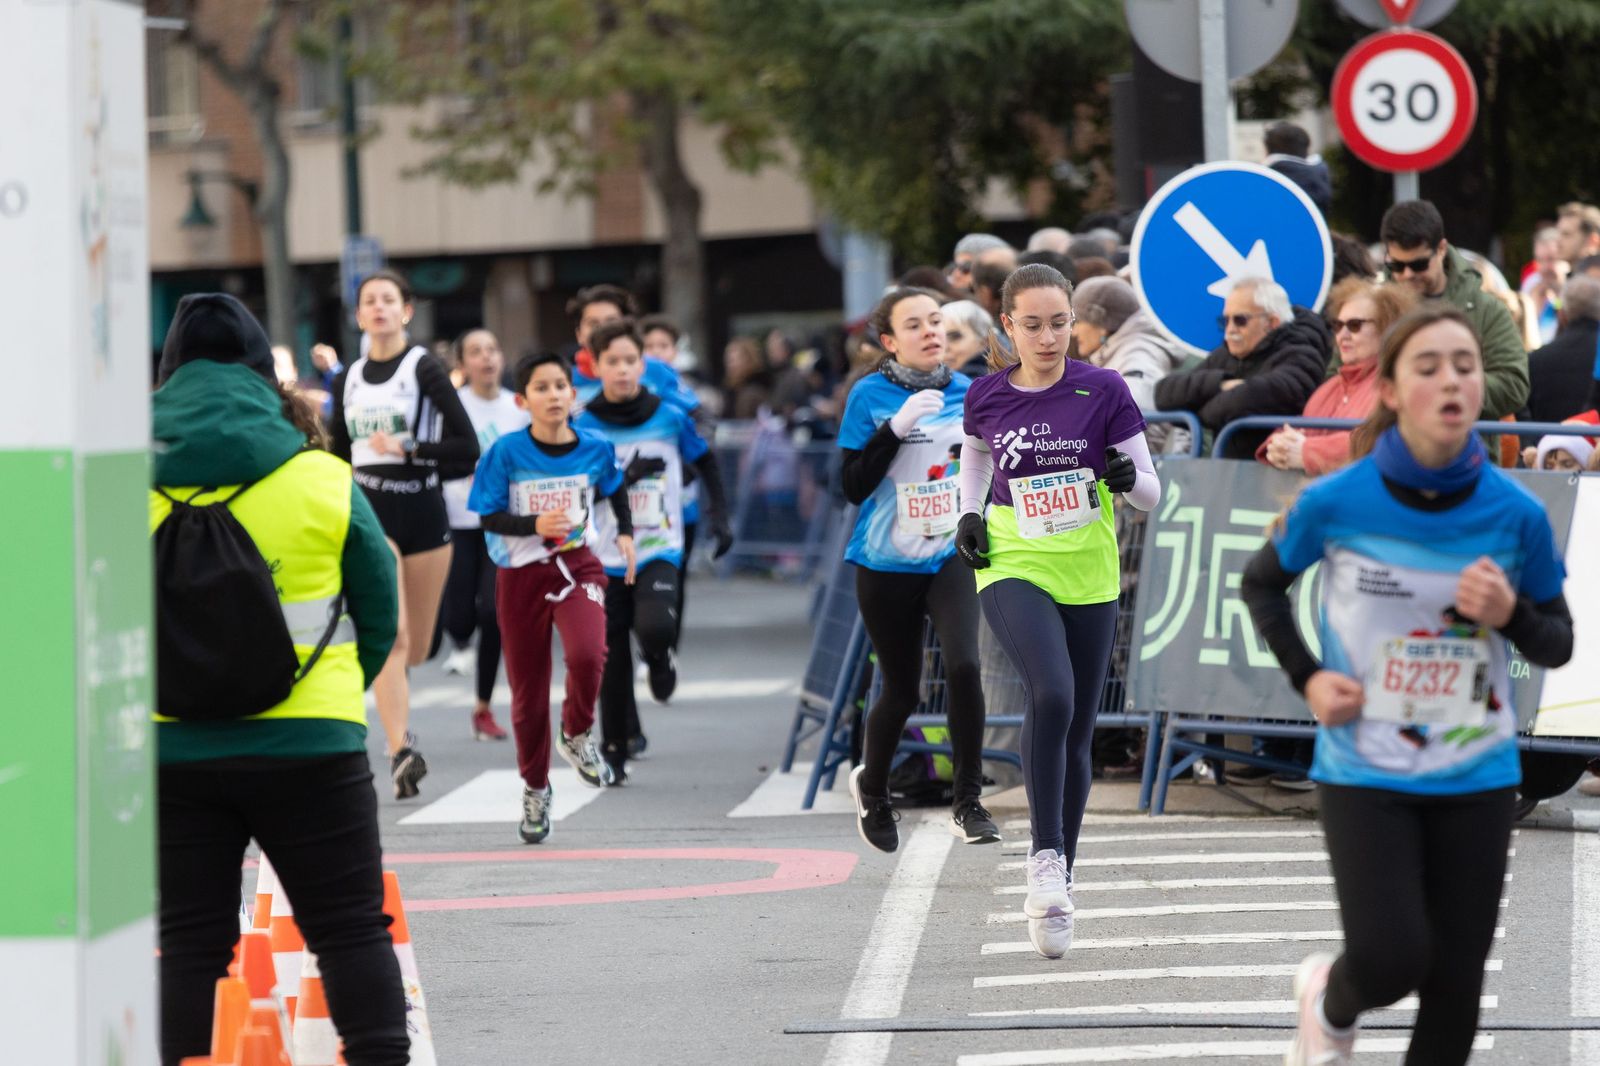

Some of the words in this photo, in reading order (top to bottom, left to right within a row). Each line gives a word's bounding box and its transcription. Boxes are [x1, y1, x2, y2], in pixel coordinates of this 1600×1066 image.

[1368, 82, 1439, 122] 30
[1031, 423, 1051, 436] C.D.
[1034, 437, 1088, 453] Abadengo
[1036, 454, 1079, 467] Running
[381, 478, 422, 494] PRO
[539, 480, 579, 491] SETEL
[917, 481, 956, 494] SETEL
[1031, 473, 1085, 490] SETEL
[528, 490, 572, 514] 6256
[908, 493, 951, 518] 6263
[1023, 486, 1079, 518] 6340
[1406, 641, 1478, 659] SETEL
[1384, 658, 1461, 696] 6232
